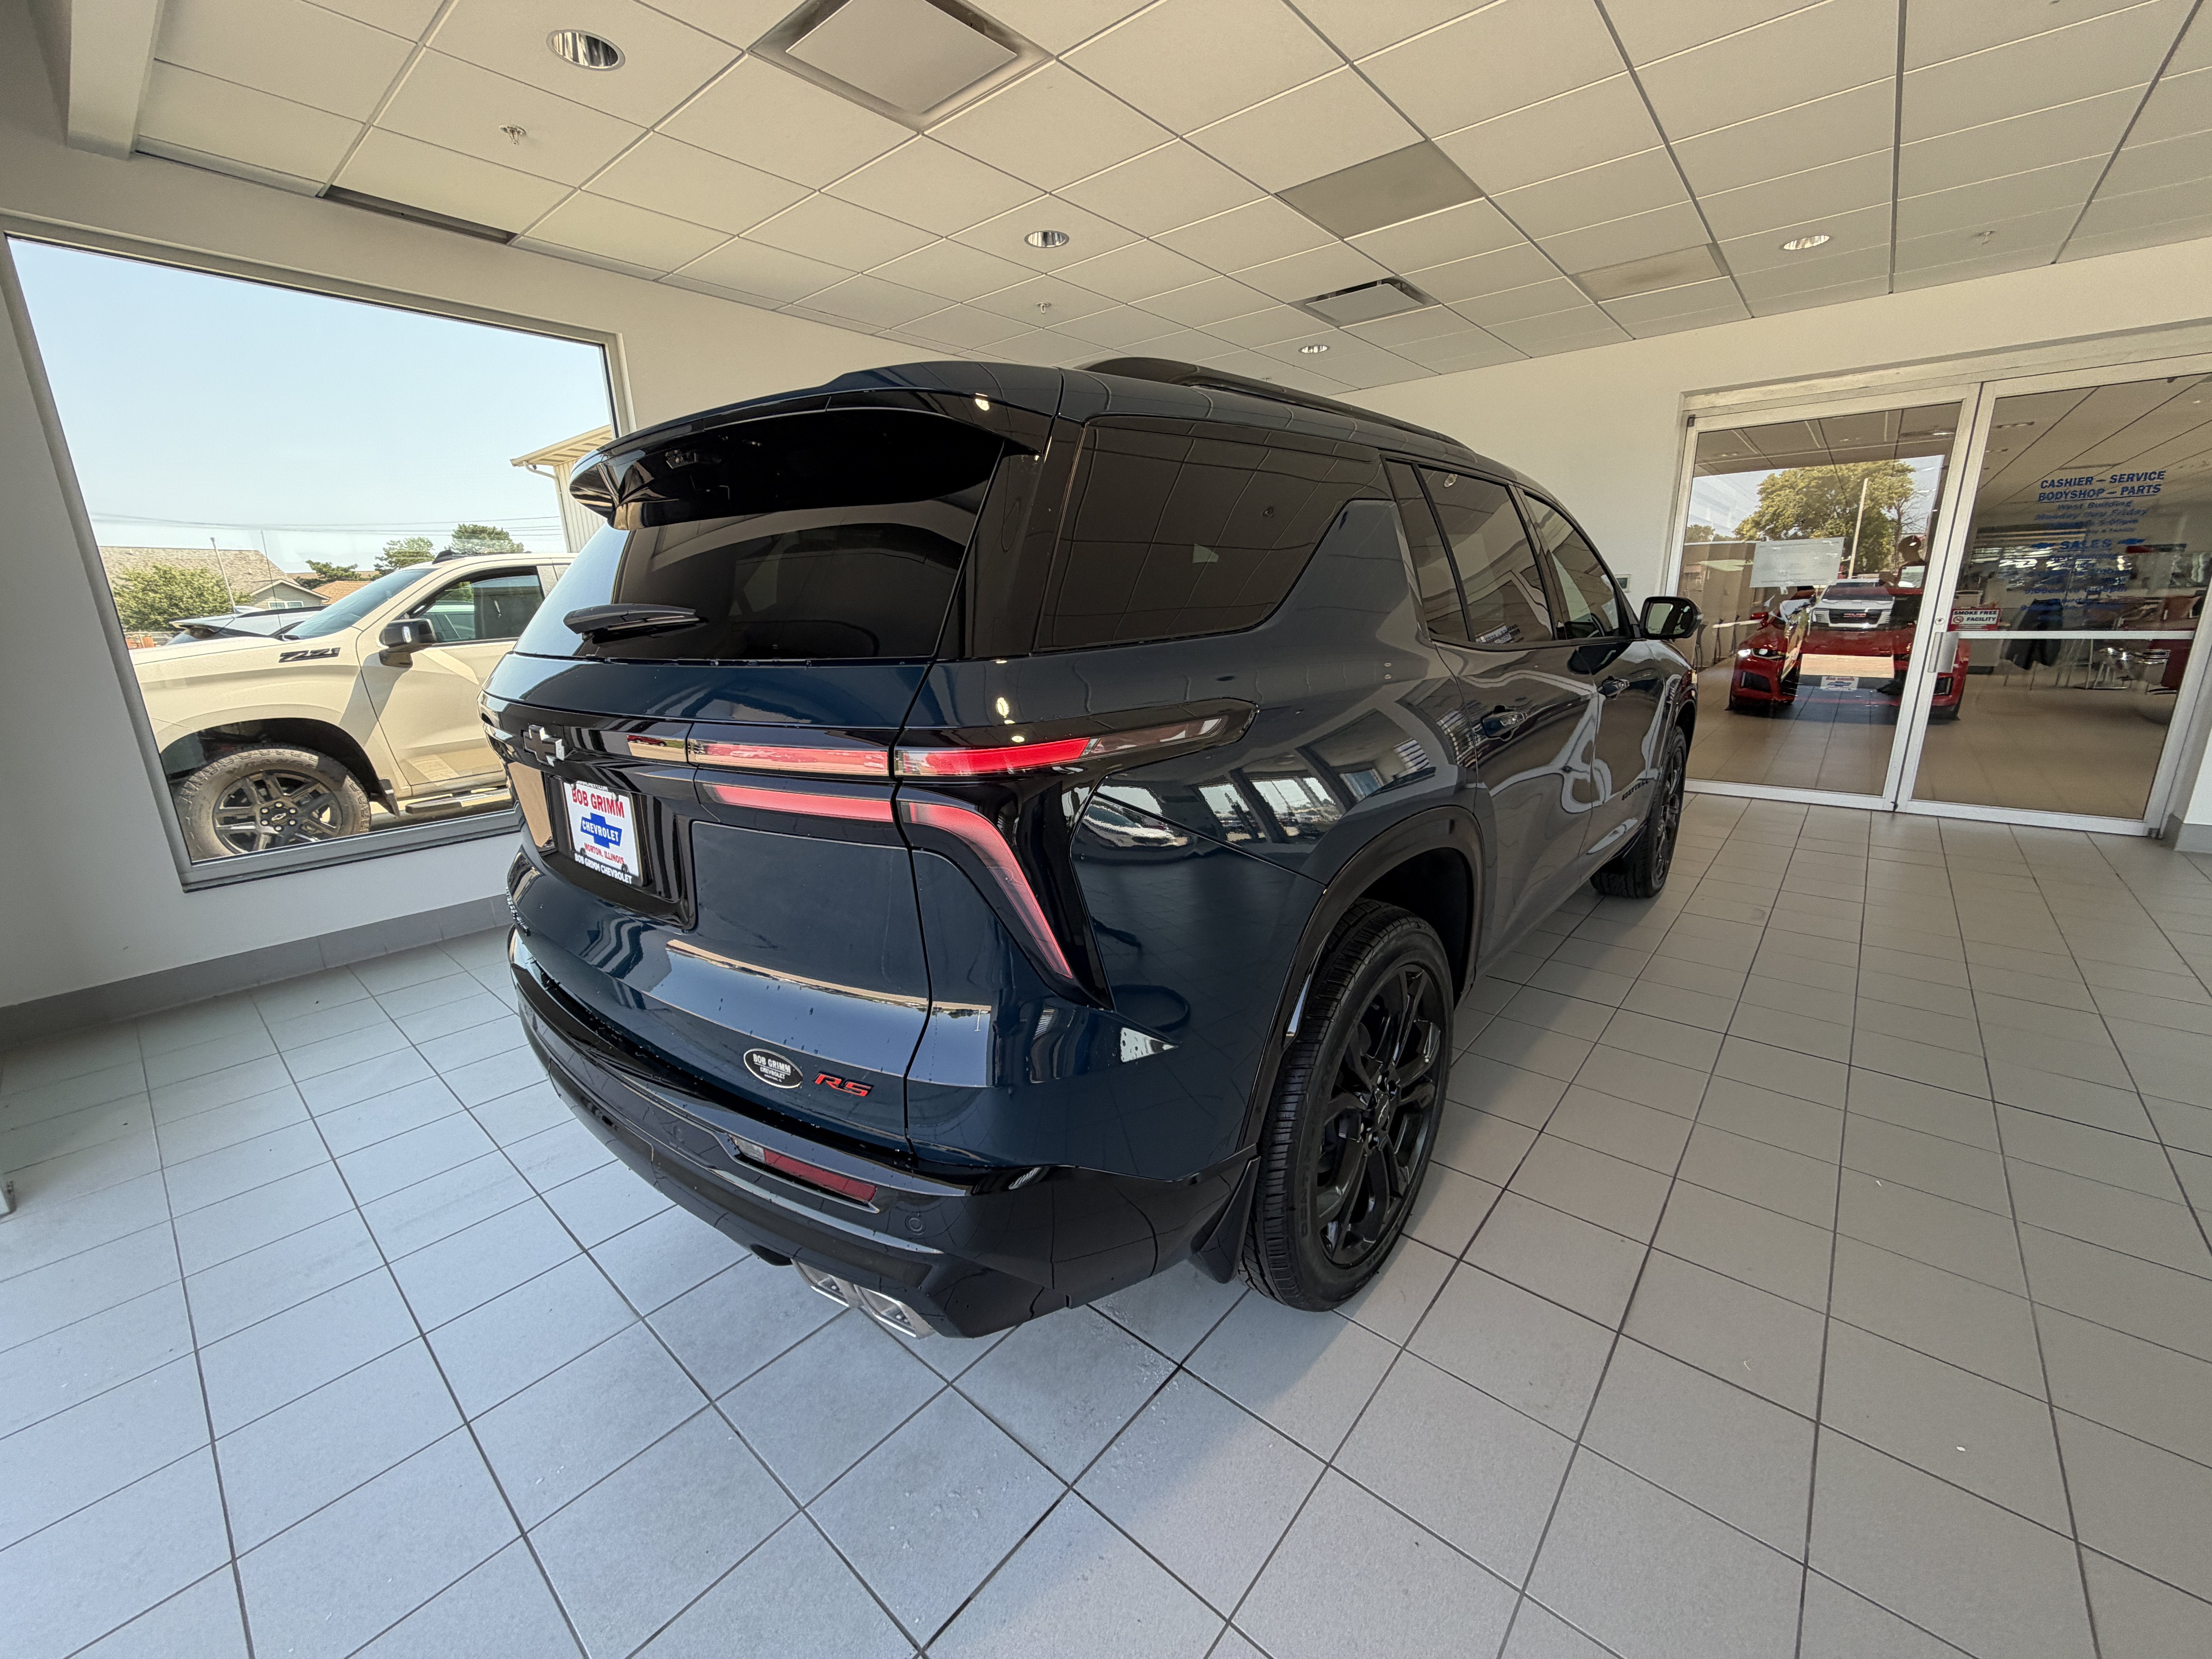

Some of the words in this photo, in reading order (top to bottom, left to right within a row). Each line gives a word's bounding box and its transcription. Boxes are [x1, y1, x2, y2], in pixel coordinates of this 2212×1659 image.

[2040, 476, 2094, 489] CASHIER
[2109, 471, 2166, 484] SERVICE
[2038, 488, 2105, 501] BODYSHOP
[2120, 484, 2161, 496] PARTS
[2061, 539, 2111, 549] SALES
[278, 647, 341, 663] Z71
[571, 788, 589, 807] BOB
[590, 793, 625, 819] GRIMM
[582, 819, 619, 842] CHEVROLET
[584, 842, 603, 859] MORTON,
[604, 850, 625, 865] ILLINOIS
[574, 853, 584, 865] BOB
[584, 859, 601, 872] GRIMM
[600, 864, 632, 885] CHEVROLET
[753, 1053, 767, 1066] BOB
[768, 1058, 792, 1074] GRIMM
[760, 1066, 786, 1080] CHEVROLET
[815, 1072, 872, 1097] RS
